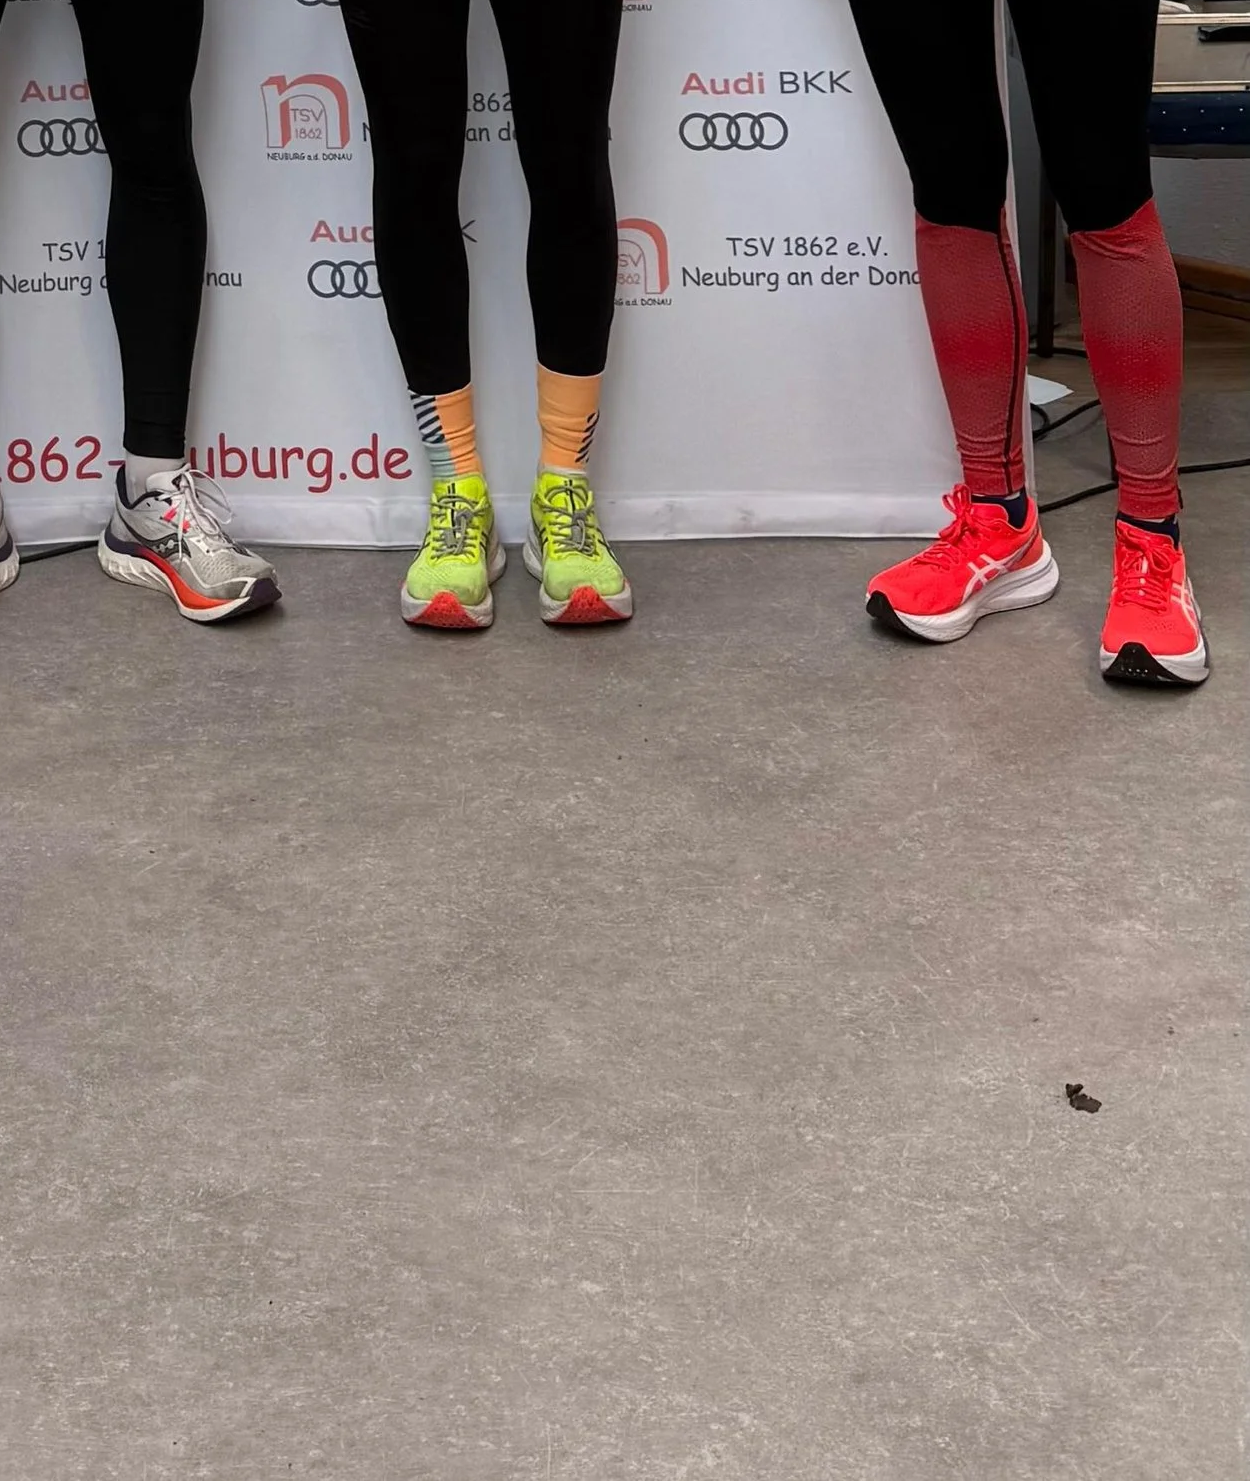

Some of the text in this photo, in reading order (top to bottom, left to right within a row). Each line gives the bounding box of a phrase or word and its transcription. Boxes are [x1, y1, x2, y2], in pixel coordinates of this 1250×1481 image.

[20, 78, 90, 104] Aud
[680, 70, 853, 96] Audi BKK
[467, 92, 513, 113] 862
[291, 106, 324, 123] TSV
[293, 126, 323, 140] 1862
[465, 126, 491, 142] an
[321, 150, 353, 162] DONAU
[42, 240, 89, 262] TSV
[725, 236, 889, 257] TSV 1862 e.V.
[0, 271, 92, 296] Neuburg
[681, 264, 922, 292] Neuburg an der Dona
